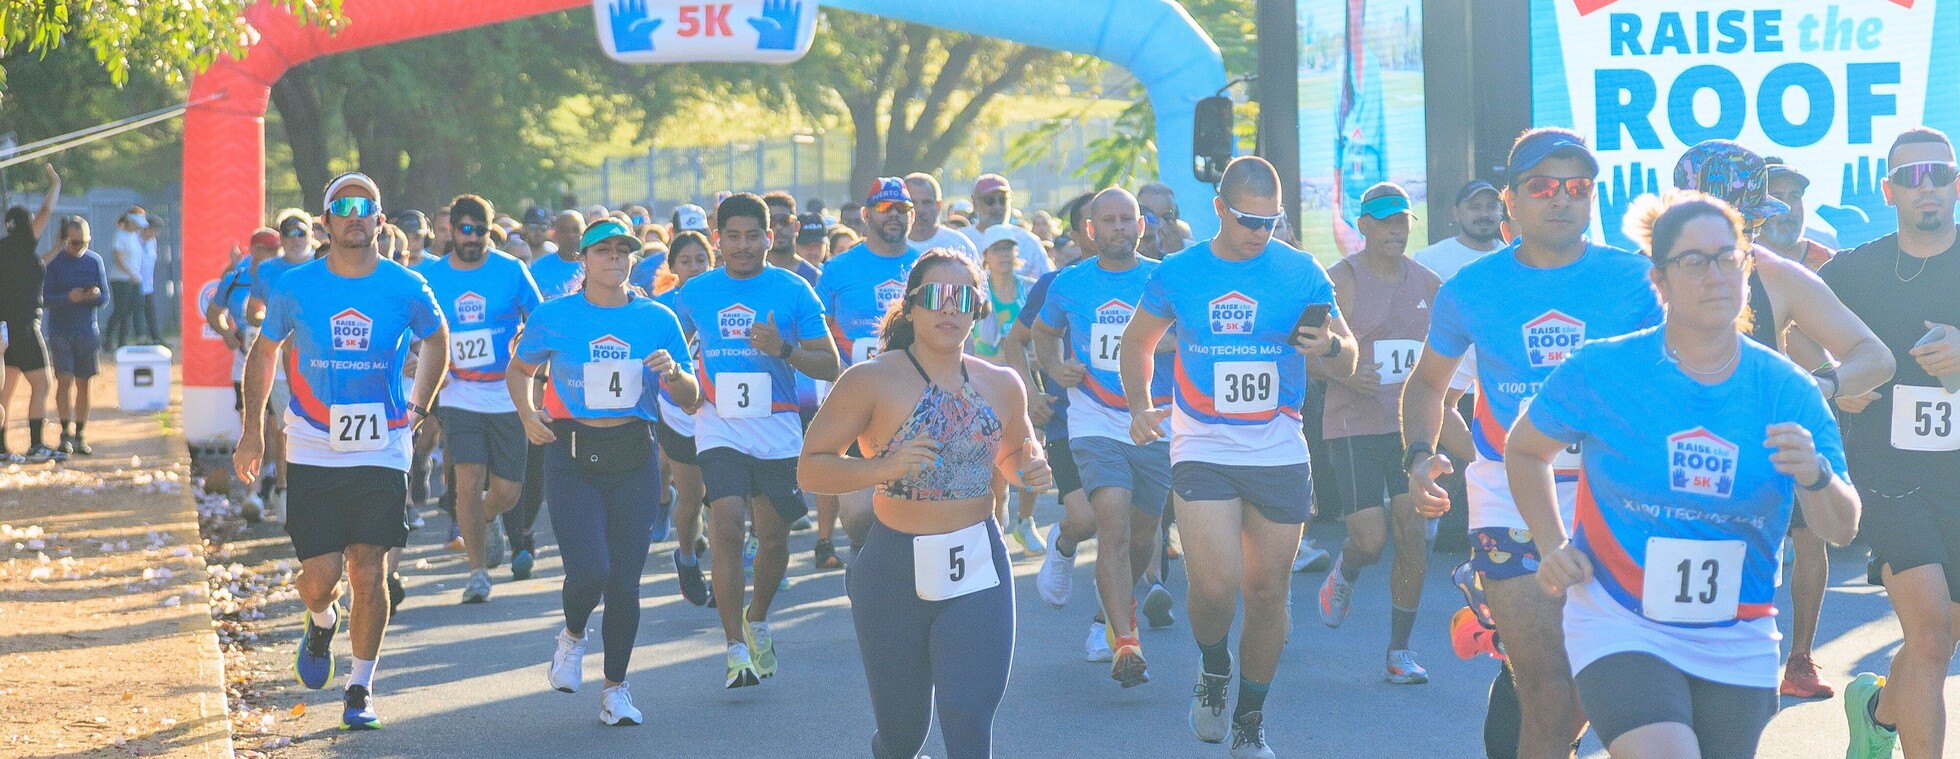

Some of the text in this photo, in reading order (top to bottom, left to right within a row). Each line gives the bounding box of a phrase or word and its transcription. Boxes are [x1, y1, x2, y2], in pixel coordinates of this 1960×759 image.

[676, 4, 734, 38] 5K
[1610, 5, 1883, 56] RAISE the
[1594, 62, 1901, 151] ROOF
[721, 318, 752, 326] ROOF
[1212, 310, 1253, 320] ROOF
[334, 326, 369, 336] ROOF
[1226, 322, 1238, 330] 5K
[1531, 326, 1560, 334] RAISE
[1528, 334, 1580, 348] ROOF
[456, 338, 488, 361] 322
[593, 349, 627, 360] ROOF
[721, 348, 758, 356] TECHOS
[1210, 345, 1257, 355] TECHOS
[1548, 352, 1563, 361] 5K
[330, 360, 370, 370] TECHOS
[1392, 349, 1415, 374] 14
[609, 371, 622, 397] 4
[1225, 372, 1271, 402] 369
[1498, 382, 1526, 393] X100
[737, 382, 749, 408] 3
[1915, 401, 1952, 437] 53
[340, 414, 380, 441] 271
[1678, 442, 1711, 454] RAISE
[1673, 451, 1732, 473] ROOF
[1693, 475, 1712, 488] 5K
[950, 545, 965, 582] 5
[1675, 559, 1719, 604] 13
